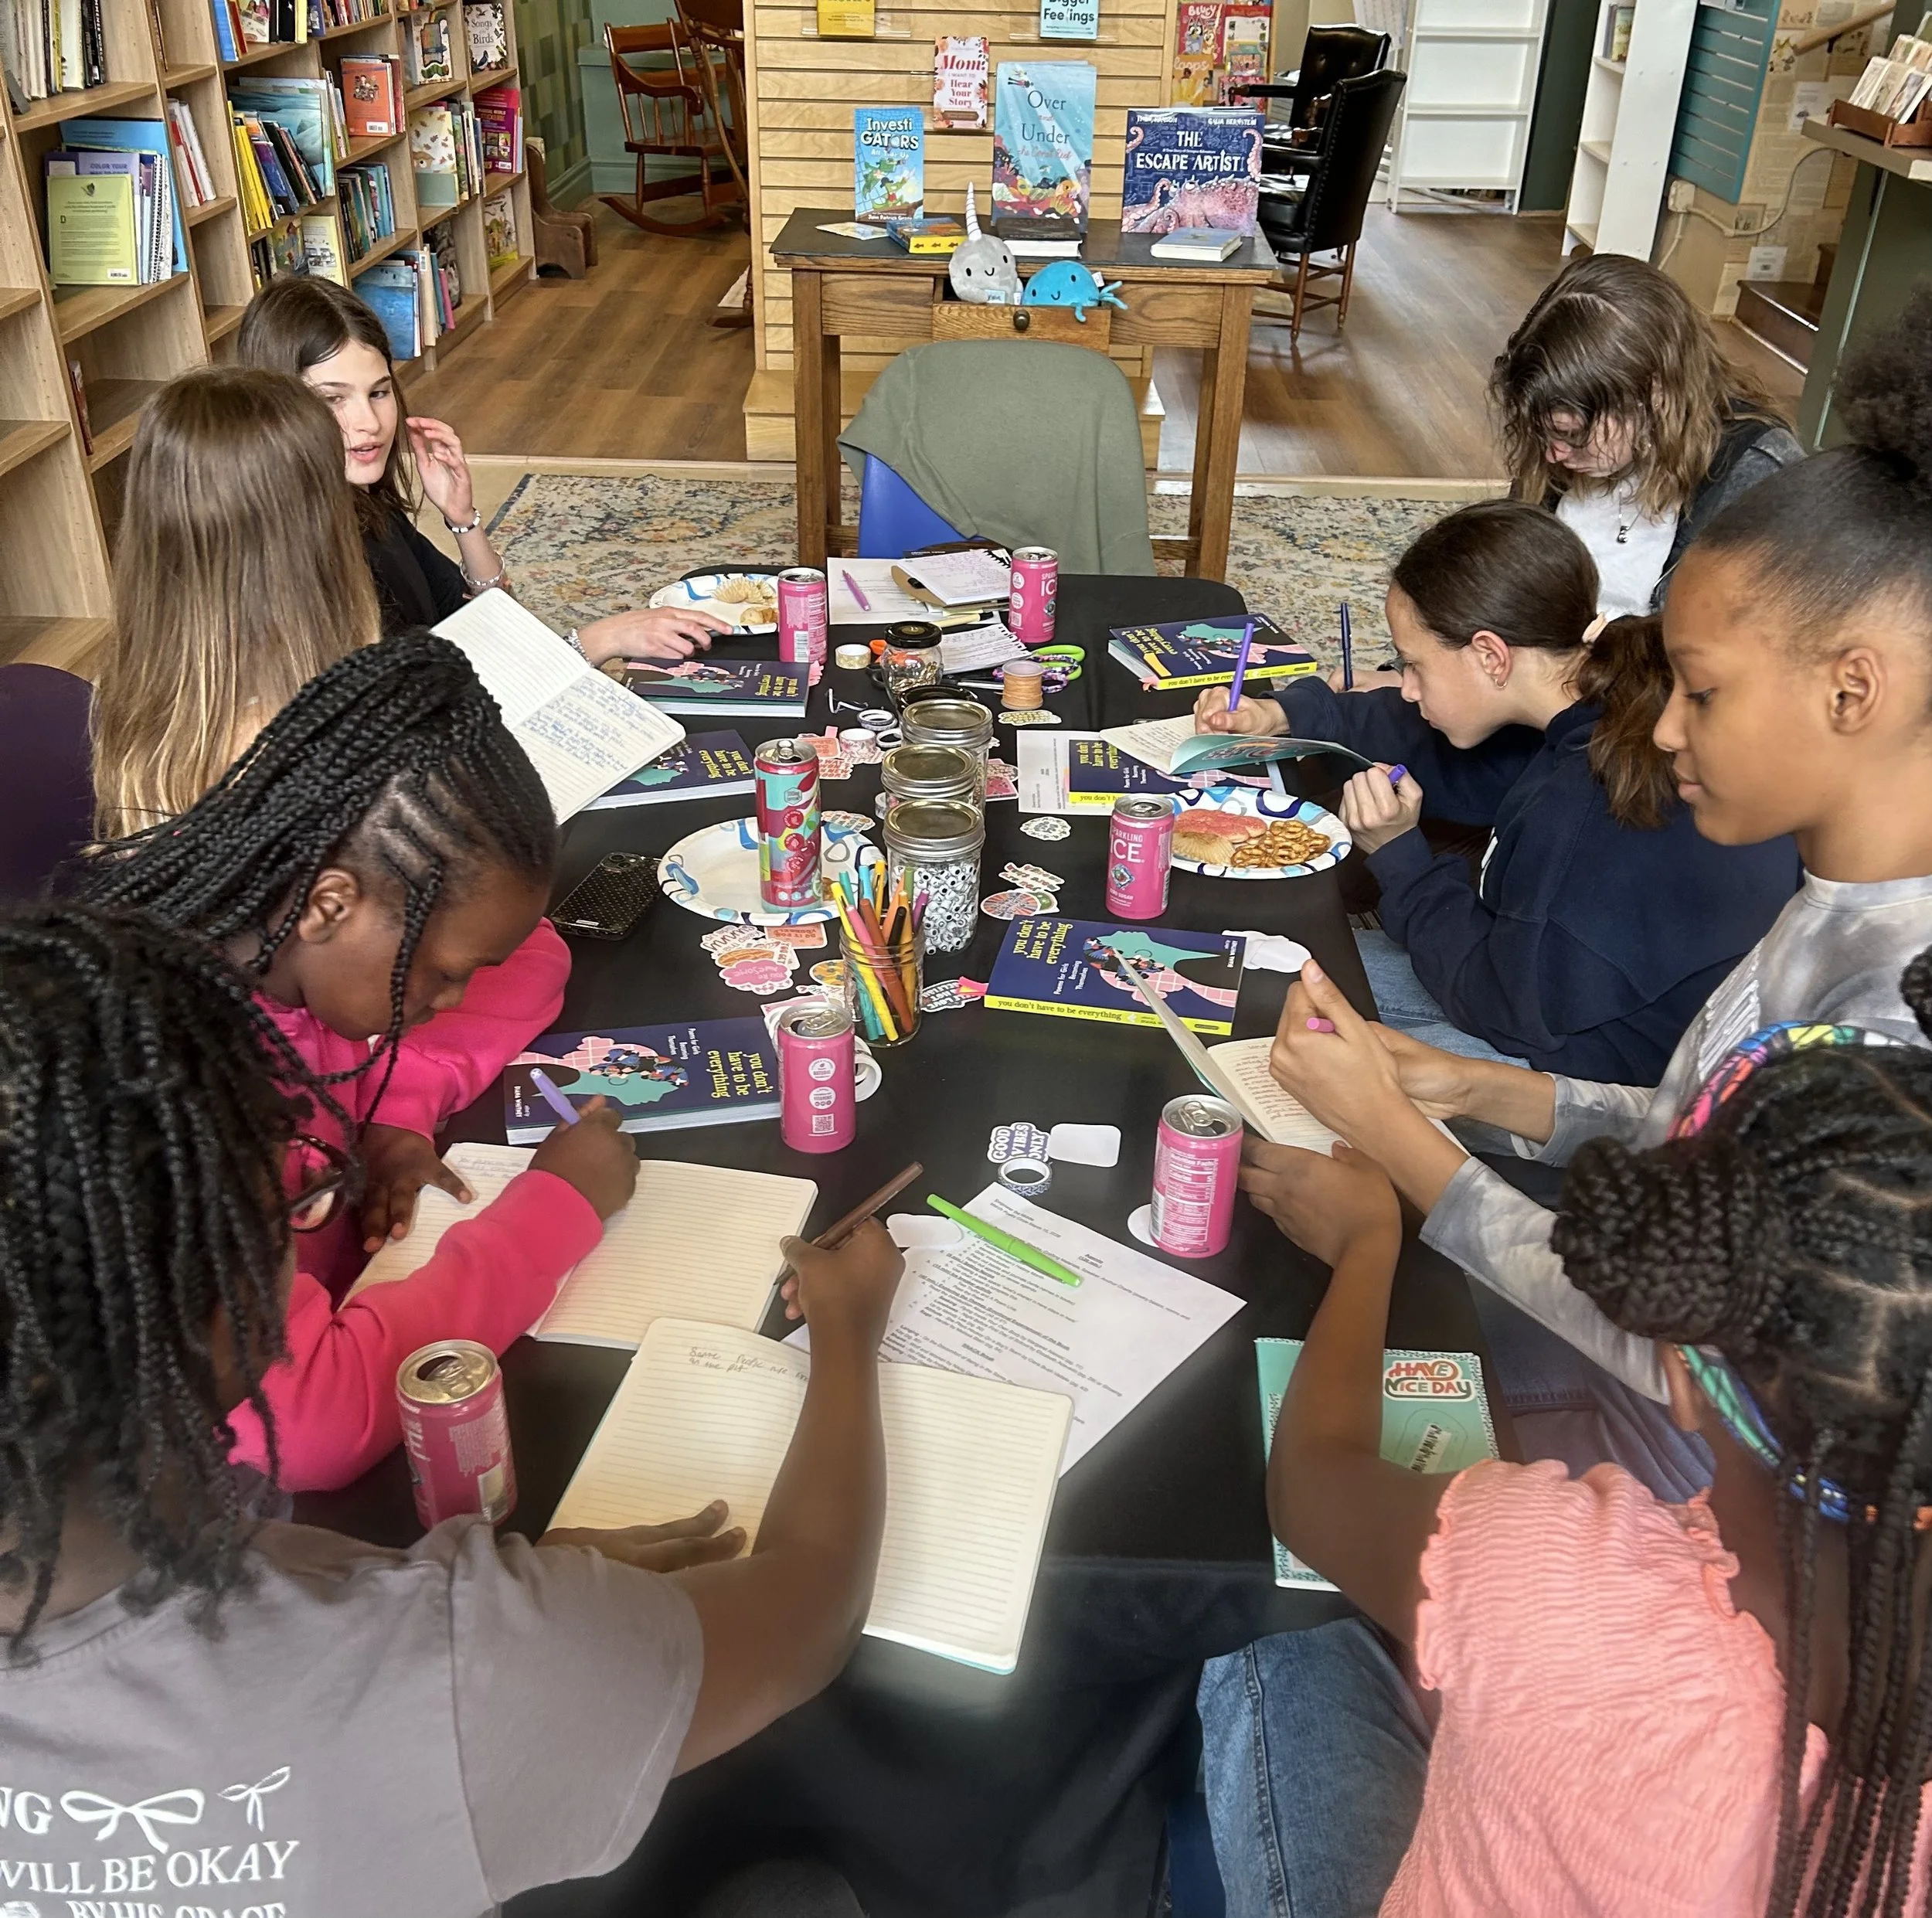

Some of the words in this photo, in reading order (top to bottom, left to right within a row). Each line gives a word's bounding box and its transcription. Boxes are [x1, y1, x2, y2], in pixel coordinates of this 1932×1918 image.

[471, 19, 492, 30] Songs
[473, 33, 494, 44] Birds
[951, 80, 973, 88] Hear
[951, 89, 971, 97] Your
[949, 98, 972, 108] Story
[1028, 90, 1066, 110] Over
[866, 117, 913, 131] Investi
[860, 131, 920, 150] GATORS
[1022, 123, 1070, 144] Under
[1176, 131, 1204, 148] THE
[1136, 153, 1189, 170] ESCAPE
[1017, 920, 1035, 938] don't
[1036, 921, 1053, 930] be
[1033, 931, 1048, 940] to
[1046, 922, 1073, 964] everything
[1013, 940, 1028, 955] you
[1026, 940, 1045, 960] have
[998, 999, 1012, 1008] you
[1015, 1001, 1035, 1009] don't
[1036, 1004, 1055, 1012] have
[1078, 1008, 1123, 1022] everything
[727, 1051, 743, 1072] have
[743, 1053, 763, 1070] you
[706, 1050, 731, 1098] everything
[733, 1073, 747, 1083] to
[752, 1070, 774, 1093] don't
[735, 1084, 751, 1096] be
[992, 1128, 1011, 1159] GOOD
[1011, 1124, 1029, 1158] VIBES
[1029, 1131, 1046, 1159] ONLY
[1389, 1361, 1456, 1380] HAVE
[1385, 1377, 1428, 1395] NICE
[1432, 1381, 1471, 1397] DAY
[102, 1855, 158, 1892] BE
[166, 1840, 301, 1888] OKAY
